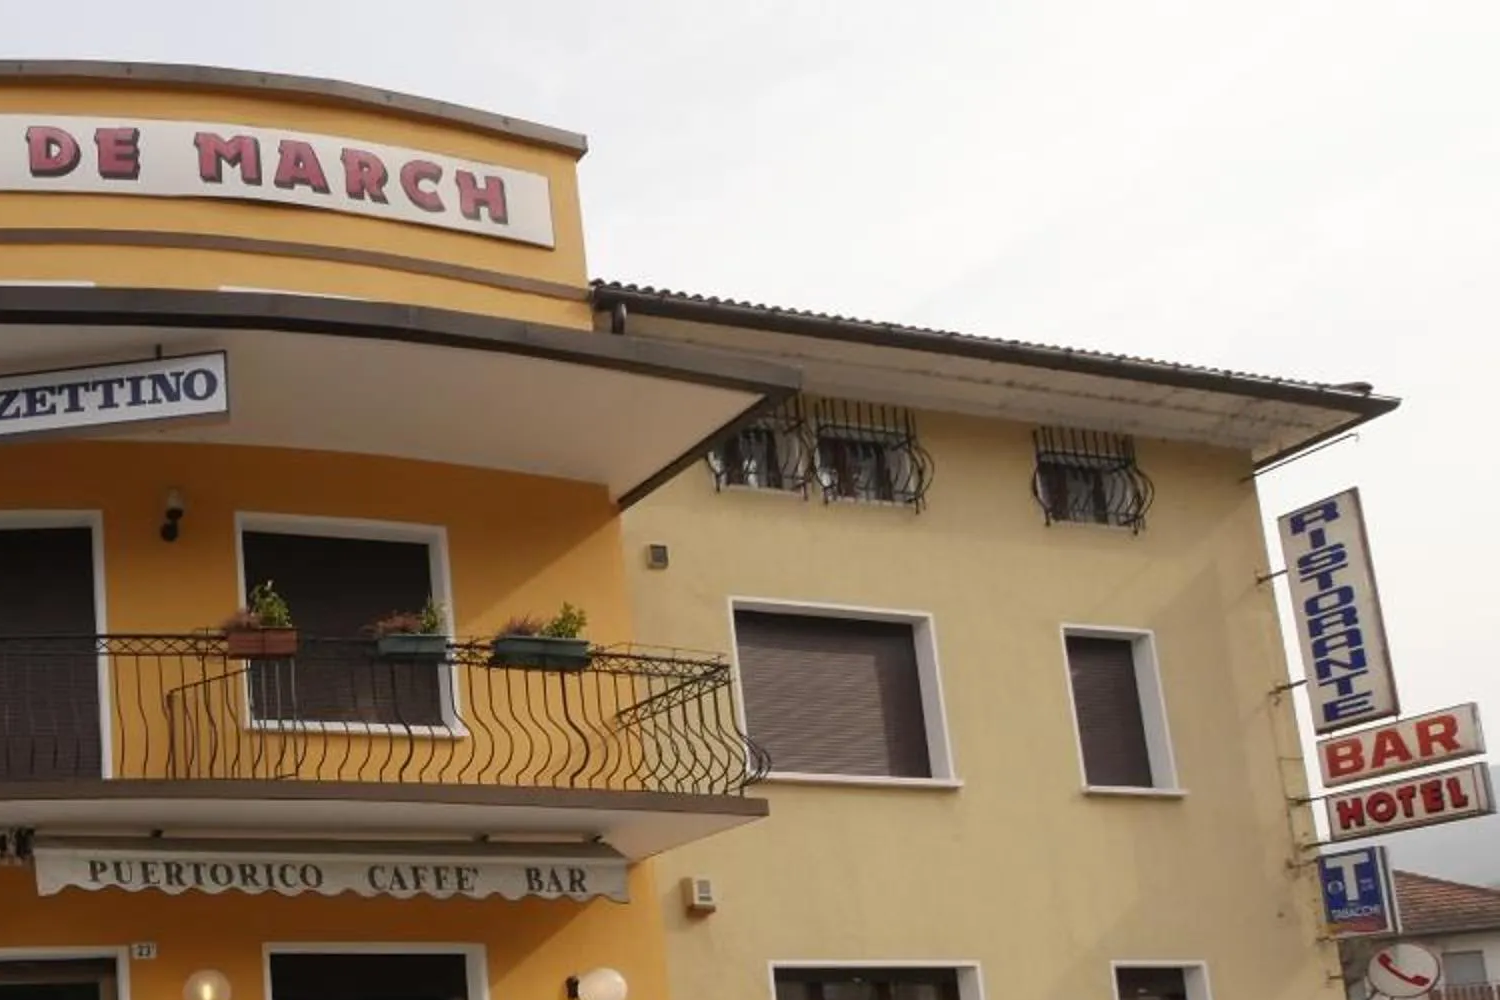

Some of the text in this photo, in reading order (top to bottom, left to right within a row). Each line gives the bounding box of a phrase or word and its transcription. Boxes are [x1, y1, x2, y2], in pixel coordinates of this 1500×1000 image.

[26, 125, 140, 181] DE
[194, 131, 508, 225] MARCH
[1290, 501, 1374, 722] RISTORANTE
[1325, 714, 1461, 778] BAR
[1336, 777, 1469, 830] HOTEL
[88, 860, 324, 889] PUERTORICO
[524, 866, 587, 893] BAR
